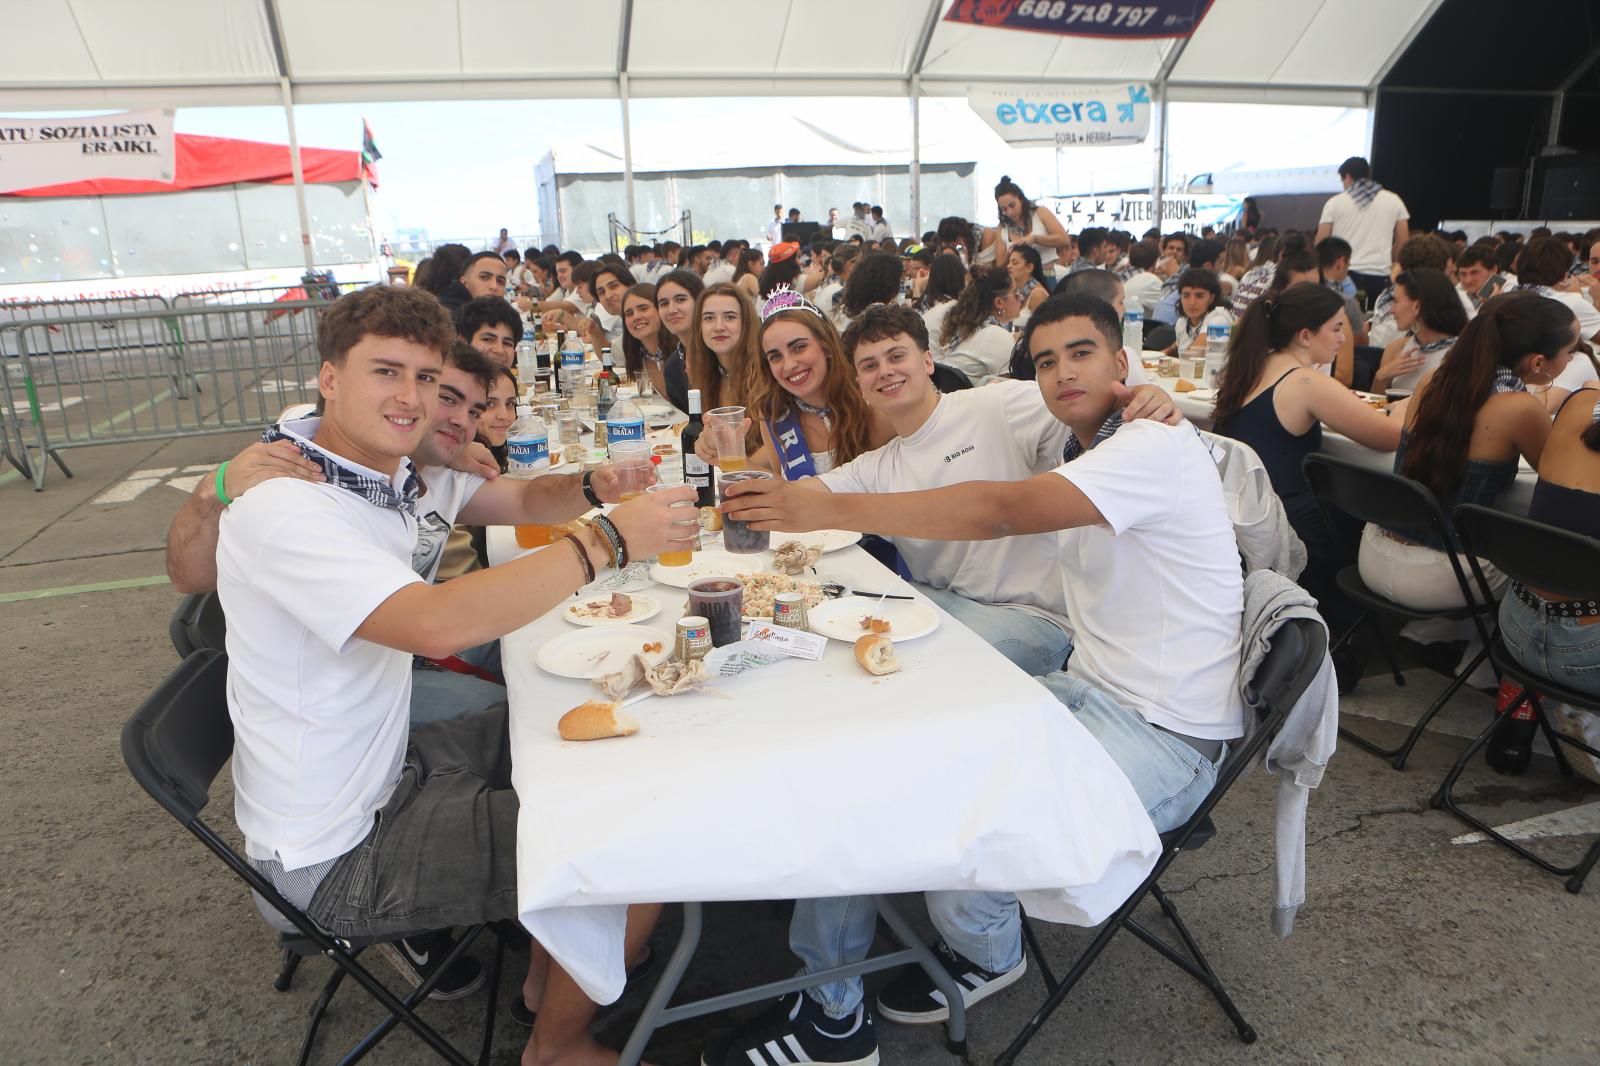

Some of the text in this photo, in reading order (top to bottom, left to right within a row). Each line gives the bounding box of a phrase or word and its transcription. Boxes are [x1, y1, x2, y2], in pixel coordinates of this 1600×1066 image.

[1017, 0, 1063, 19] 688
[1066, 1, 1110, 24] 718
[1113, 6, 1158, 28] 797
[996, 98, 1107, 125] etxera
[40, 123, 157, 140] SOZIALISTA
[1055, 132, 1076, 145] GORA
